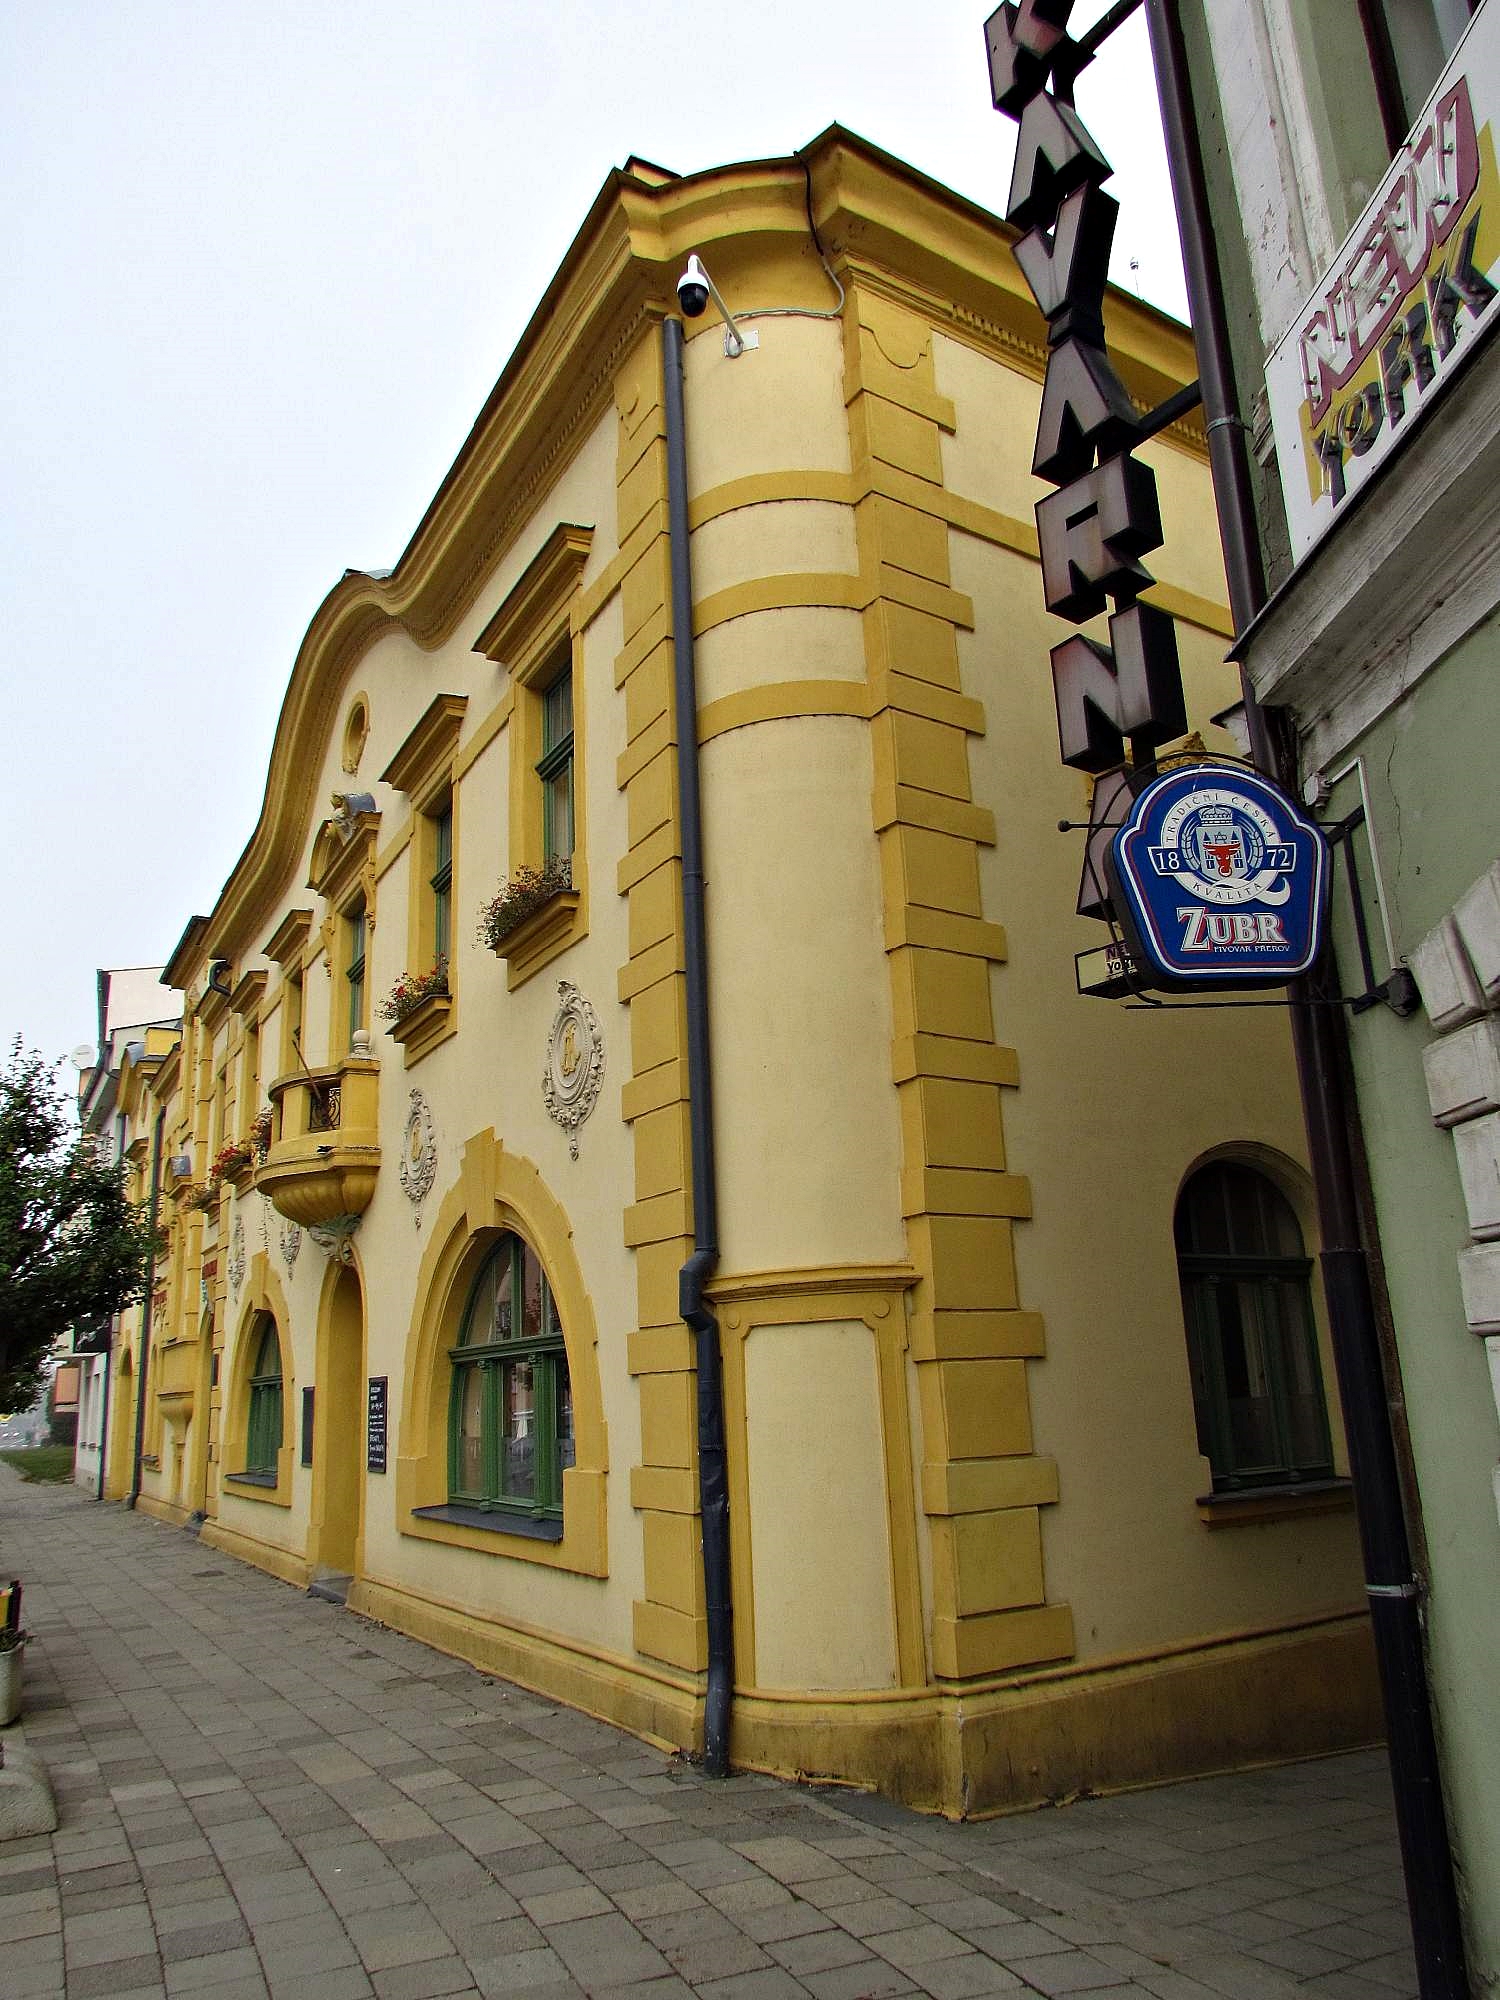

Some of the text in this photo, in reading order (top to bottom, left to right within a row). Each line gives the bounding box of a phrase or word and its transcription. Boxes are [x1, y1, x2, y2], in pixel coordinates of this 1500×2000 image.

[1313, 204, 1499, 508] YORK
[1156, 848, 1290, 870] 18 72
[1193, 882, 1262, 900] KVALITA
[1176, 907, 1289, 951] ZUBR
